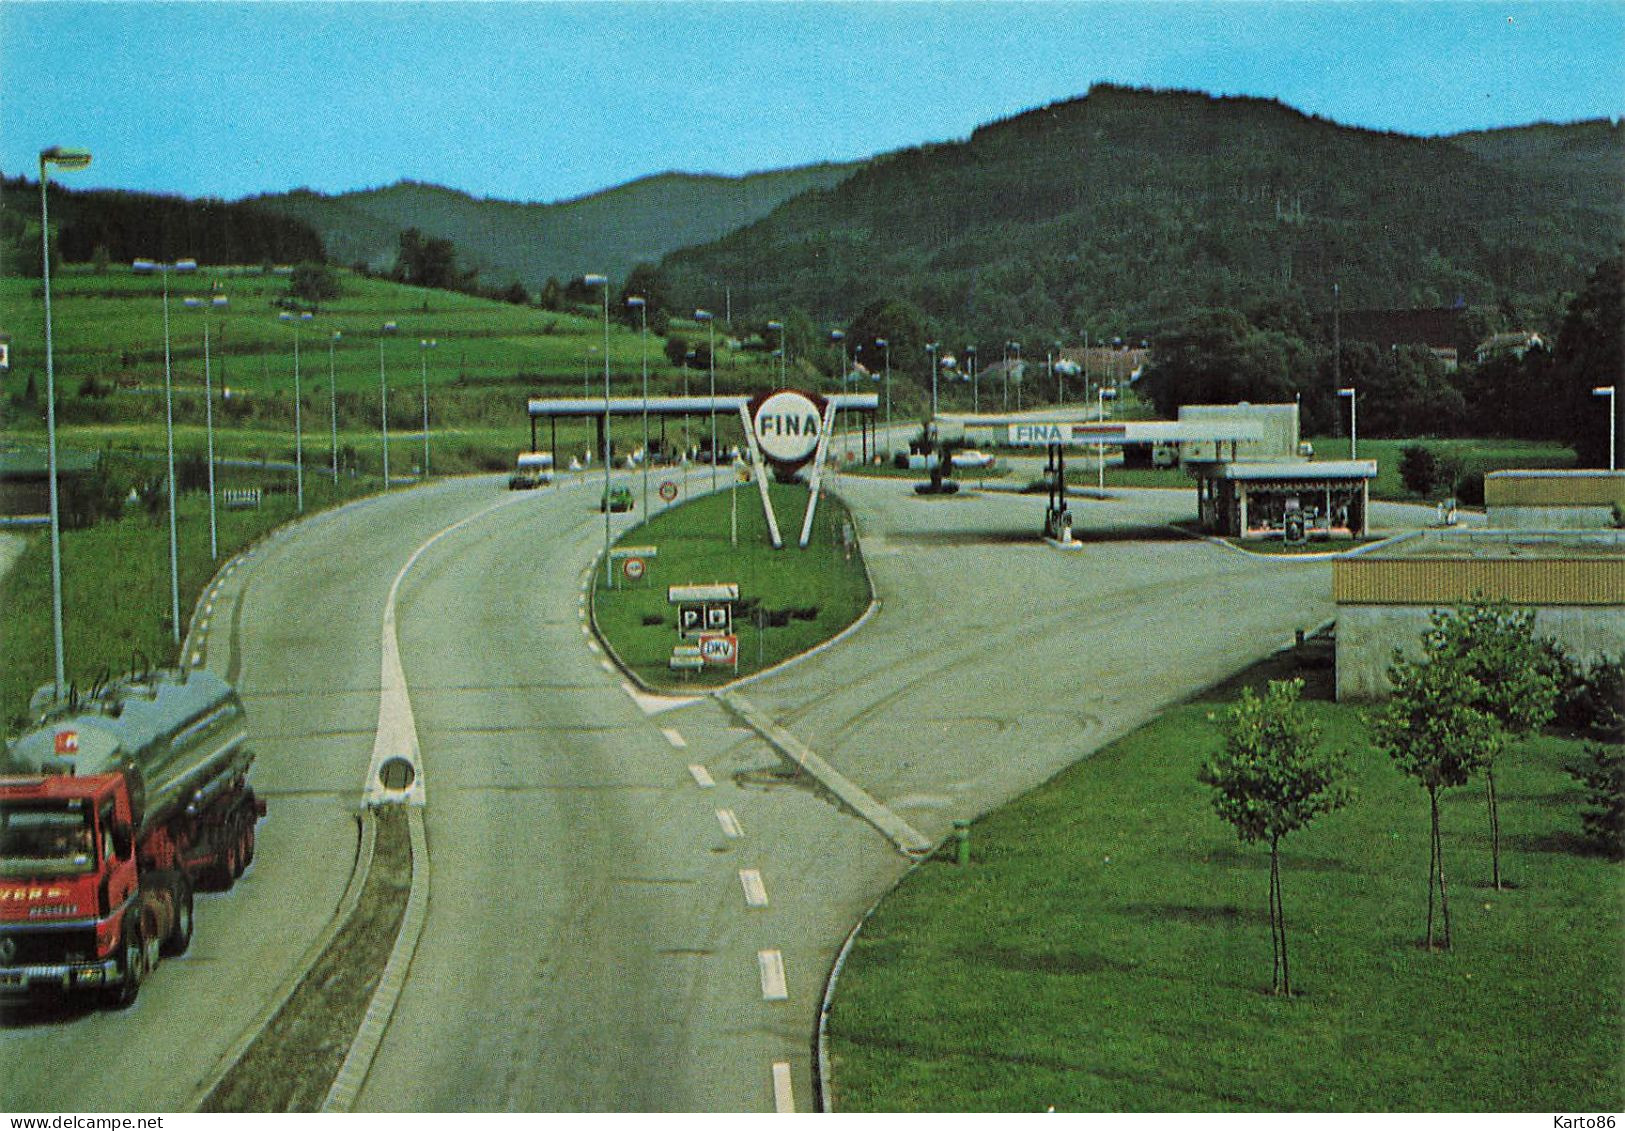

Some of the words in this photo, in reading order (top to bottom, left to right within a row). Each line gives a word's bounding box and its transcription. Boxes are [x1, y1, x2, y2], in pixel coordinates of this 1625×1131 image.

[760, 414, 818, 436] FINA
[1017, 425, 1062, 441] FINA
[684, 610, 698, 628] P
[705, 640, 730, 656] DKV
